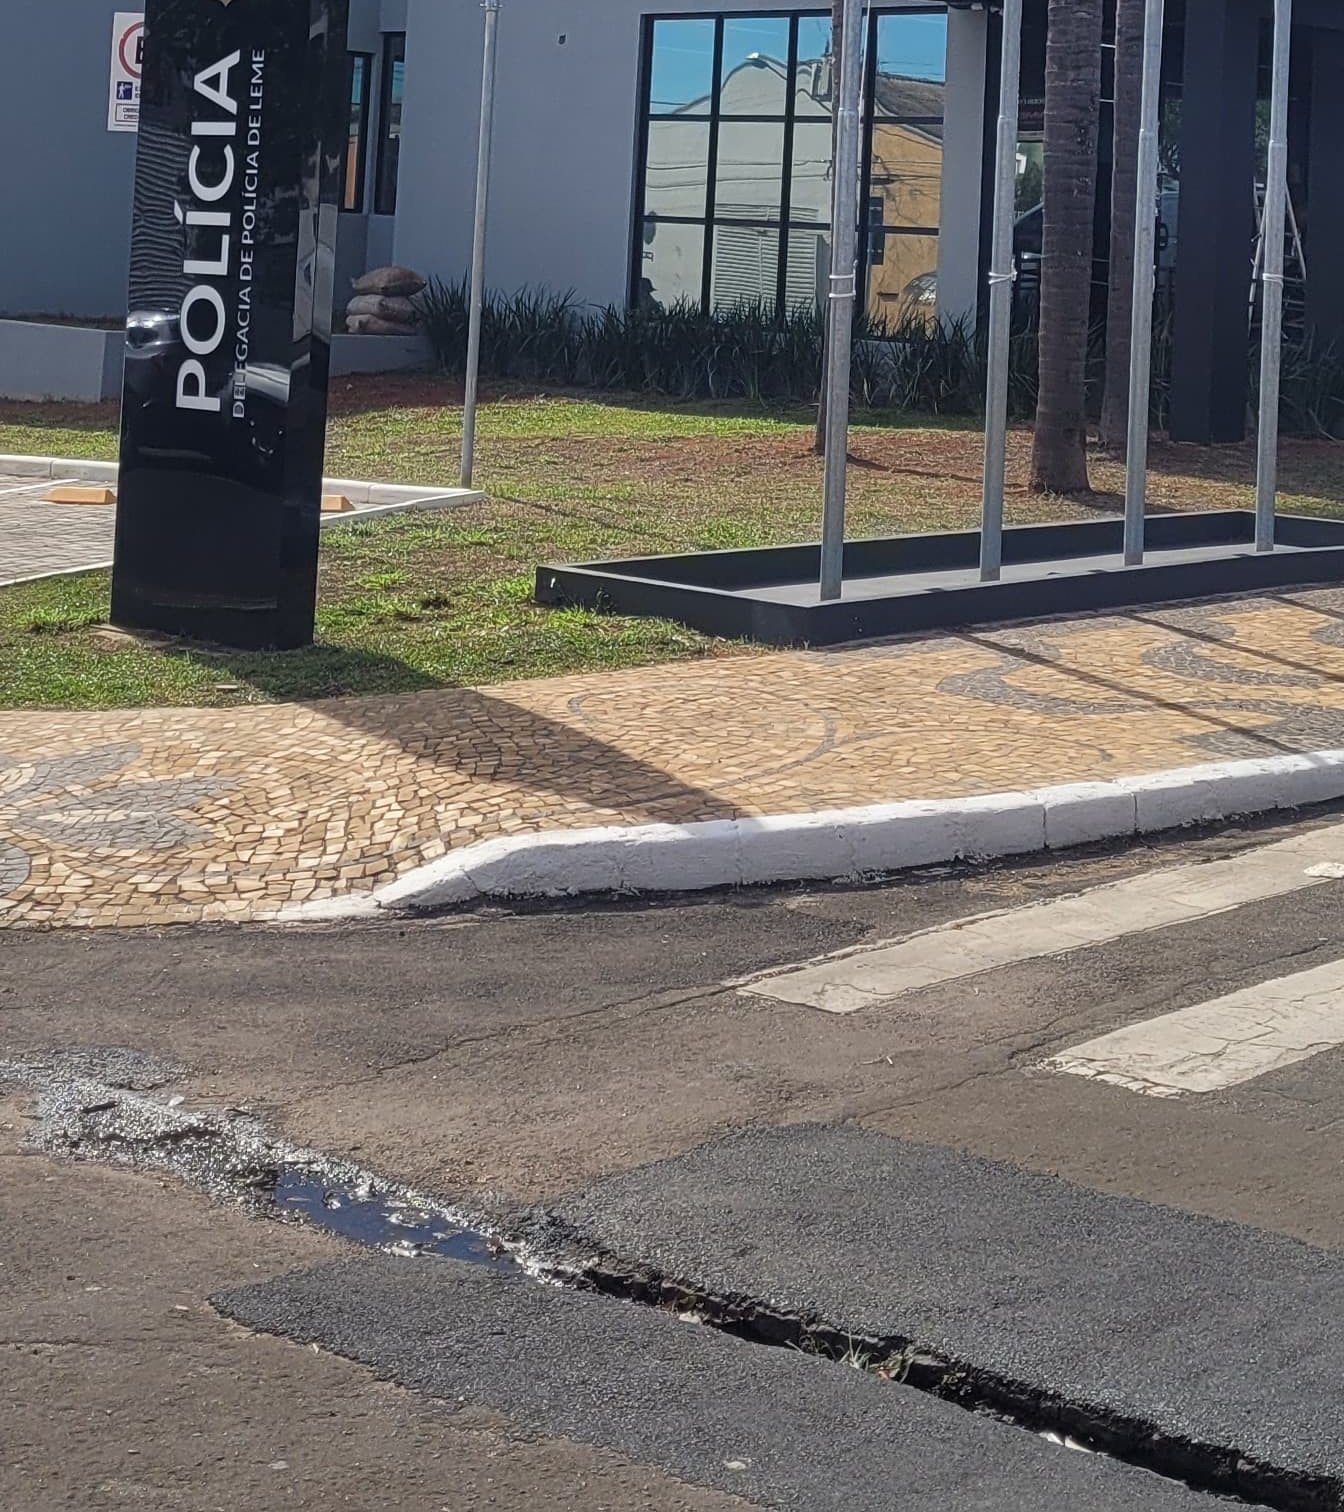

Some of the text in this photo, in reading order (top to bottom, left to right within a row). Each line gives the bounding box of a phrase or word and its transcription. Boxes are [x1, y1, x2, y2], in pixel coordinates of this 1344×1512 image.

[174, 49, 241, 412] POLÍCIA
[232, 49, 265, 418] DELEGACIA DE POLÍCIA DE LEME
